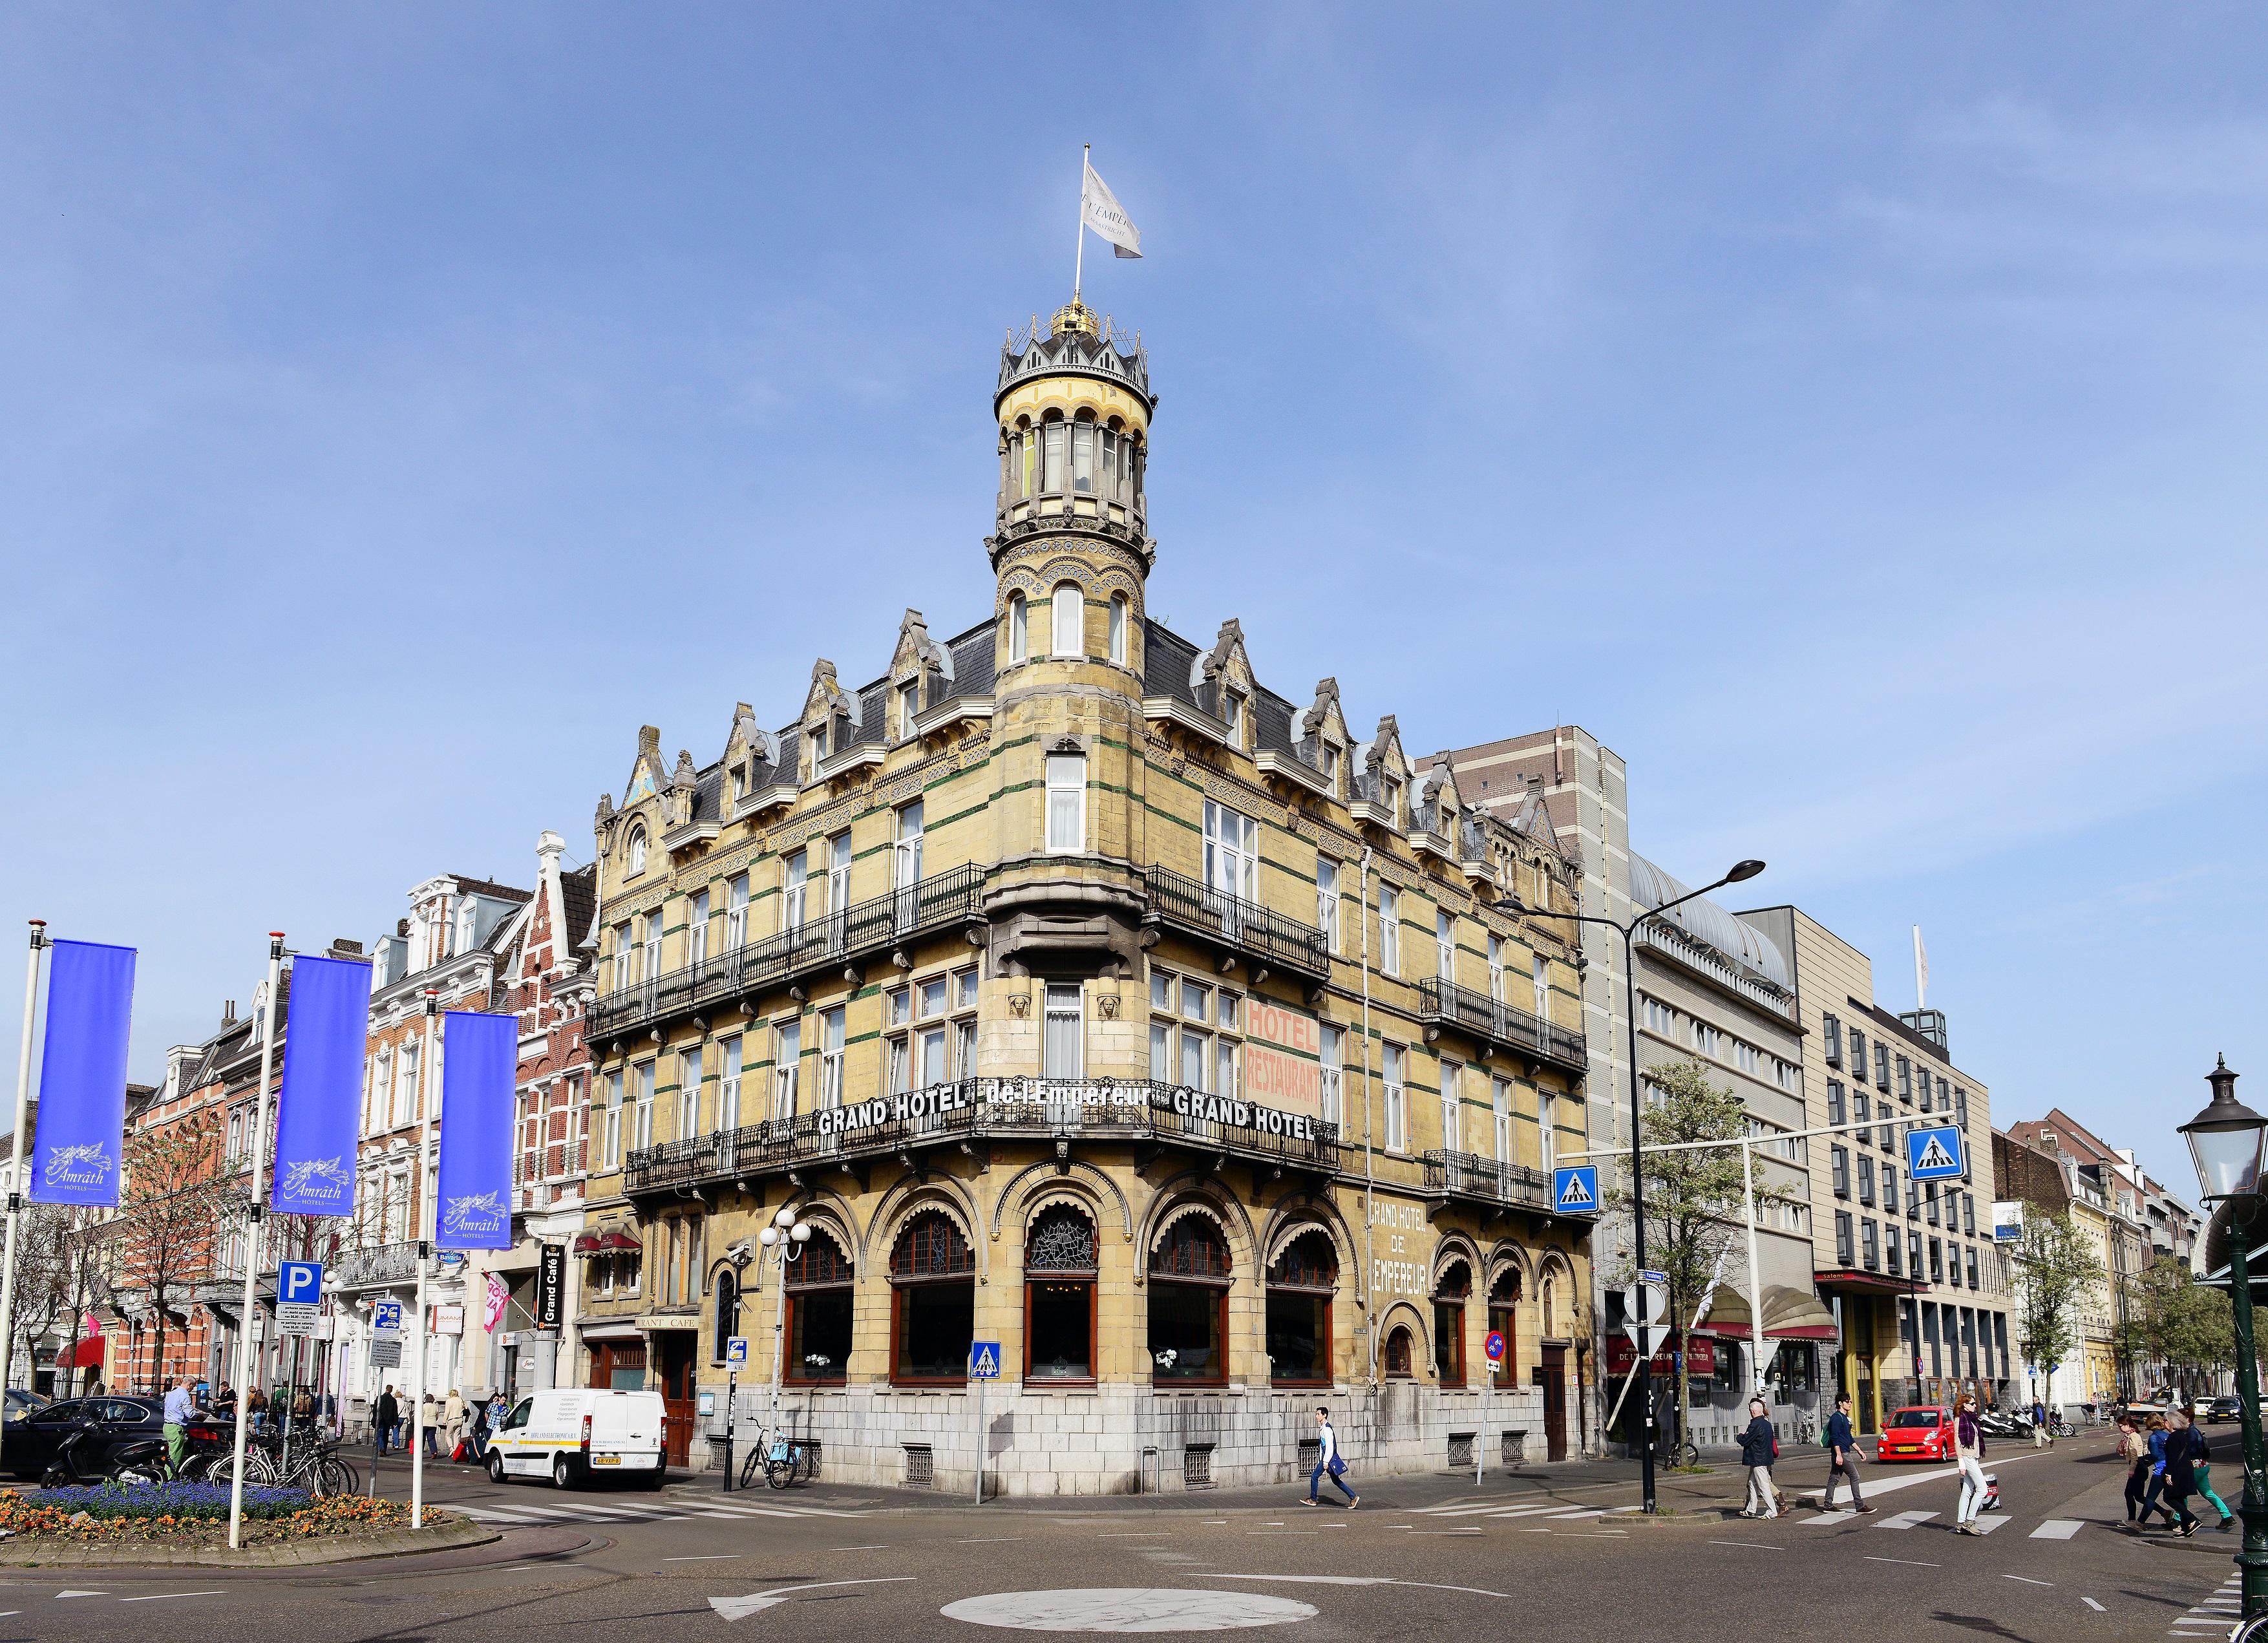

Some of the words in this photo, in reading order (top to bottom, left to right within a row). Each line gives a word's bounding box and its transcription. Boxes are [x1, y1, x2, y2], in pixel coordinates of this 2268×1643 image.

[1090, 217, 1125, 237] MAASTRICHT
[1249, 1001, 1318, 1053] HOTEL
[1247, 1047, 1320, 1105] RESTAURANT
[986, 1079, 1014, 1105] de
[818, 1101, 887, 1135] GRAND
[896, 1085, 966, 1121] HOTEL
[1174, 1089, 1247, 1126] GRAND
[1255, 1108, 1315, 1141] HOTEL
[46, 1167, 103, 1185] Amrâth
[284, 1182, 341, 1200] Amrâth
[444, 1216, 500, 1233] Amrâth
[1400, 1205, 1426, 1232] HOTEL
[1391, 1235, 1405, 1253] DE
[288, 1266, 313, 1298] P
[547, 1258, 557, 1284] Café
[1372, 1259, 1426, 1295] 'EMPEREUR
[377, 1306, 388, 1320] P
[545, 1286, 556, 1321] Grand
[671, 1319, 695, 1327] CAFE
